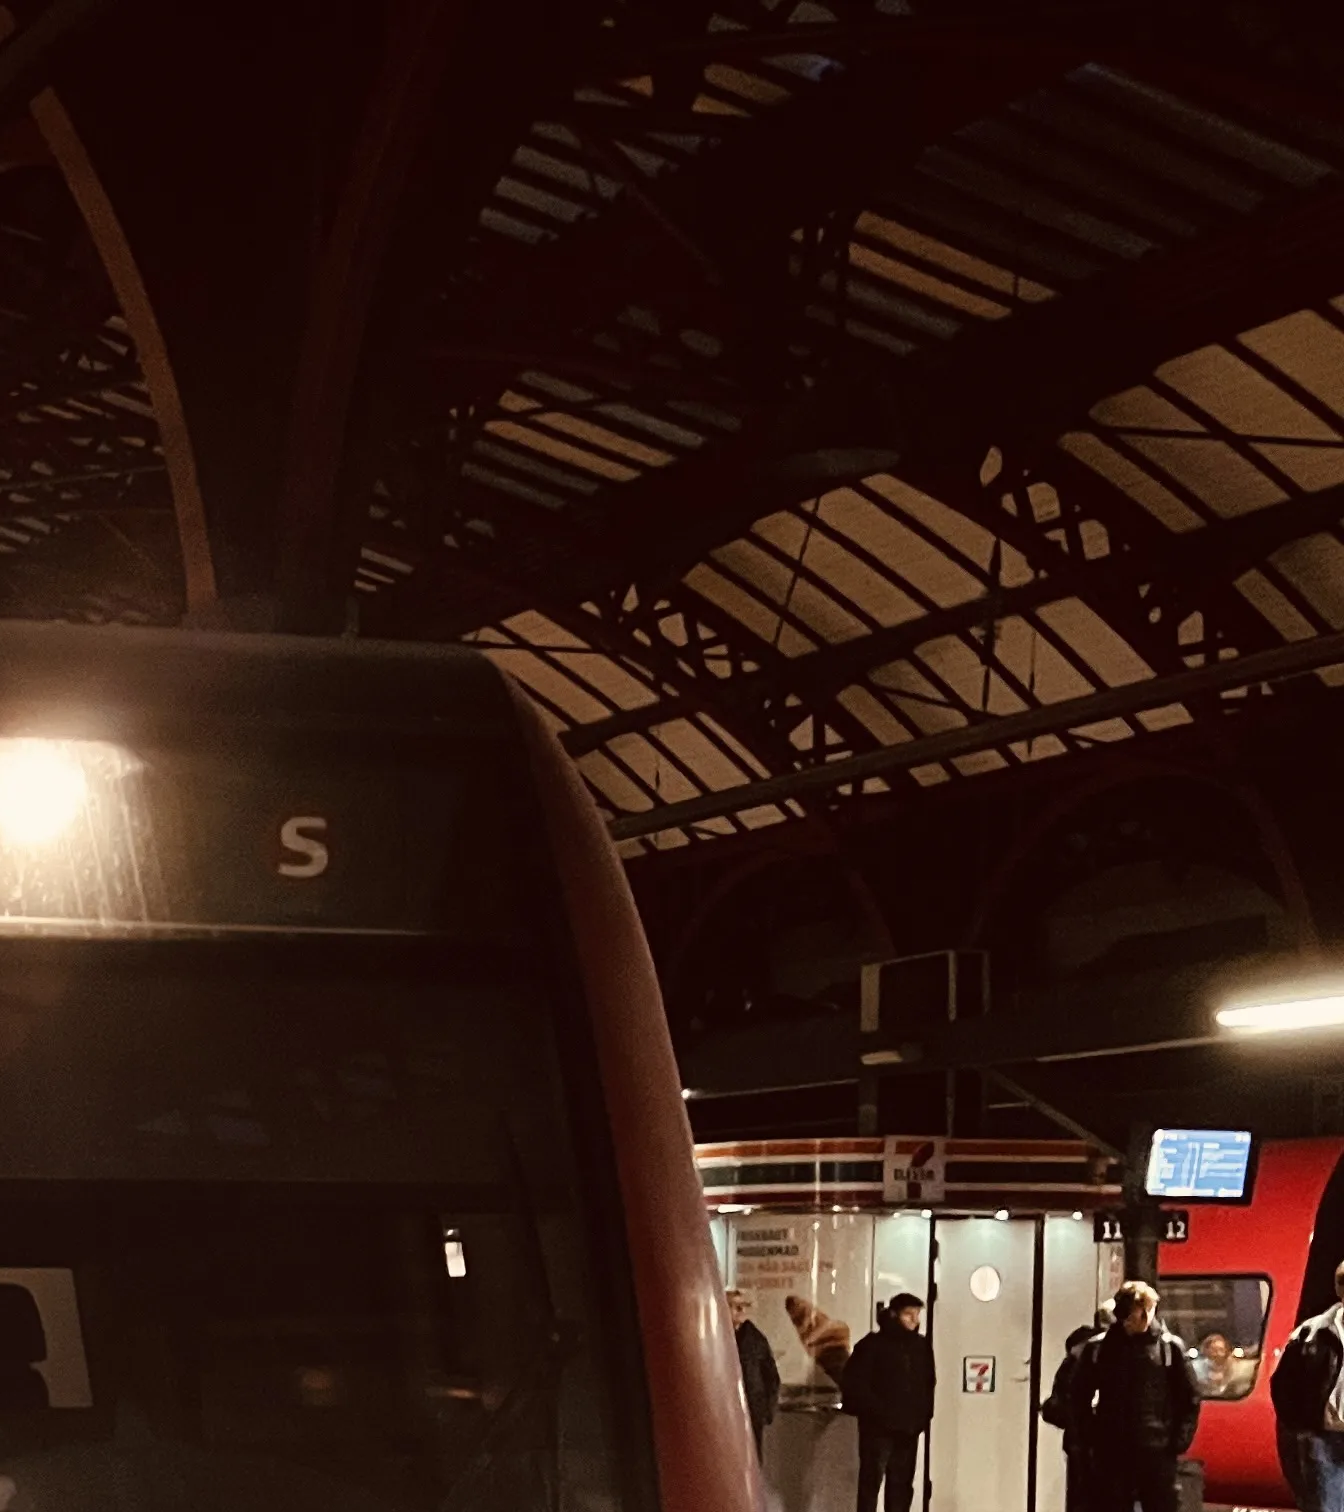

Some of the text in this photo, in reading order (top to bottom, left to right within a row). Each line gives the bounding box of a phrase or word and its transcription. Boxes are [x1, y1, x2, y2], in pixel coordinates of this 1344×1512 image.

[278, 816, 328, 877] S
[1103, 1221, 1123, 1239] 11
[1166, 1221, 1186, 1239] 12
